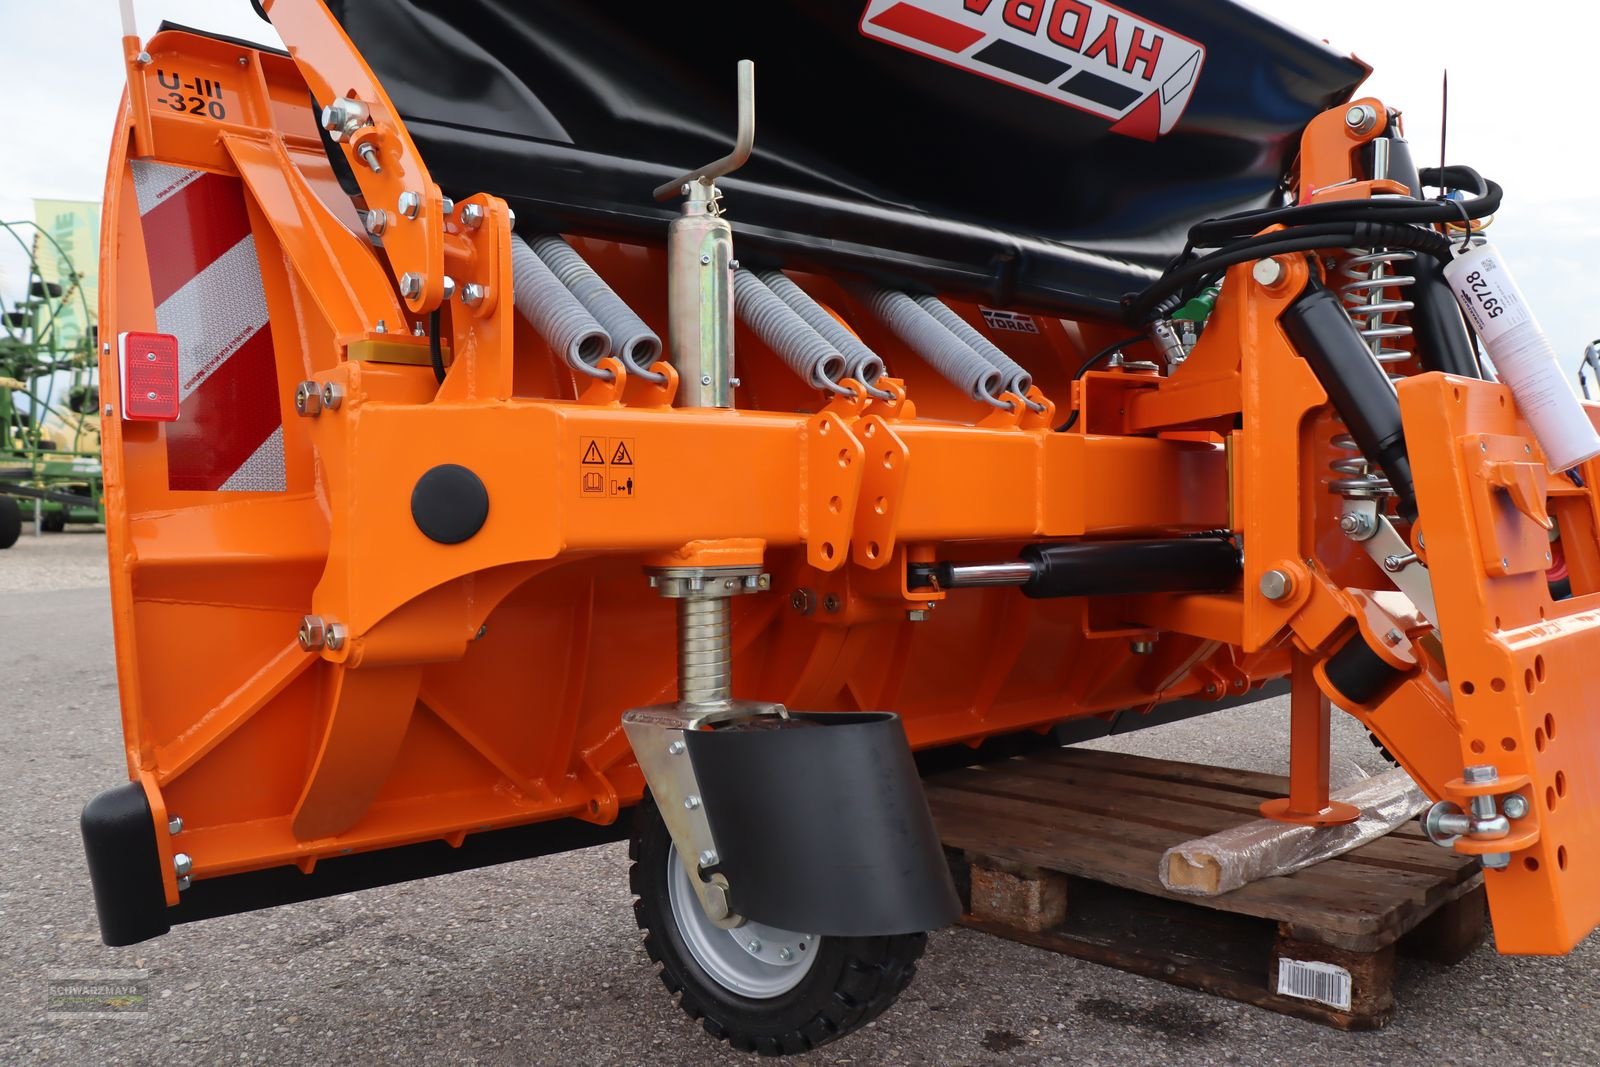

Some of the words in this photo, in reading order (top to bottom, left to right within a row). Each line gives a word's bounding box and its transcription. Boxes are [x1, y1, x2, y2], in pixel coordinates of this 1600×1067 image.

[963, 0, 1164, 82] HYDR
[157, 69, 223, 99] U-III
[157, 92, 226, 120] -320
[1466, 271, 1504, 319] 59728
